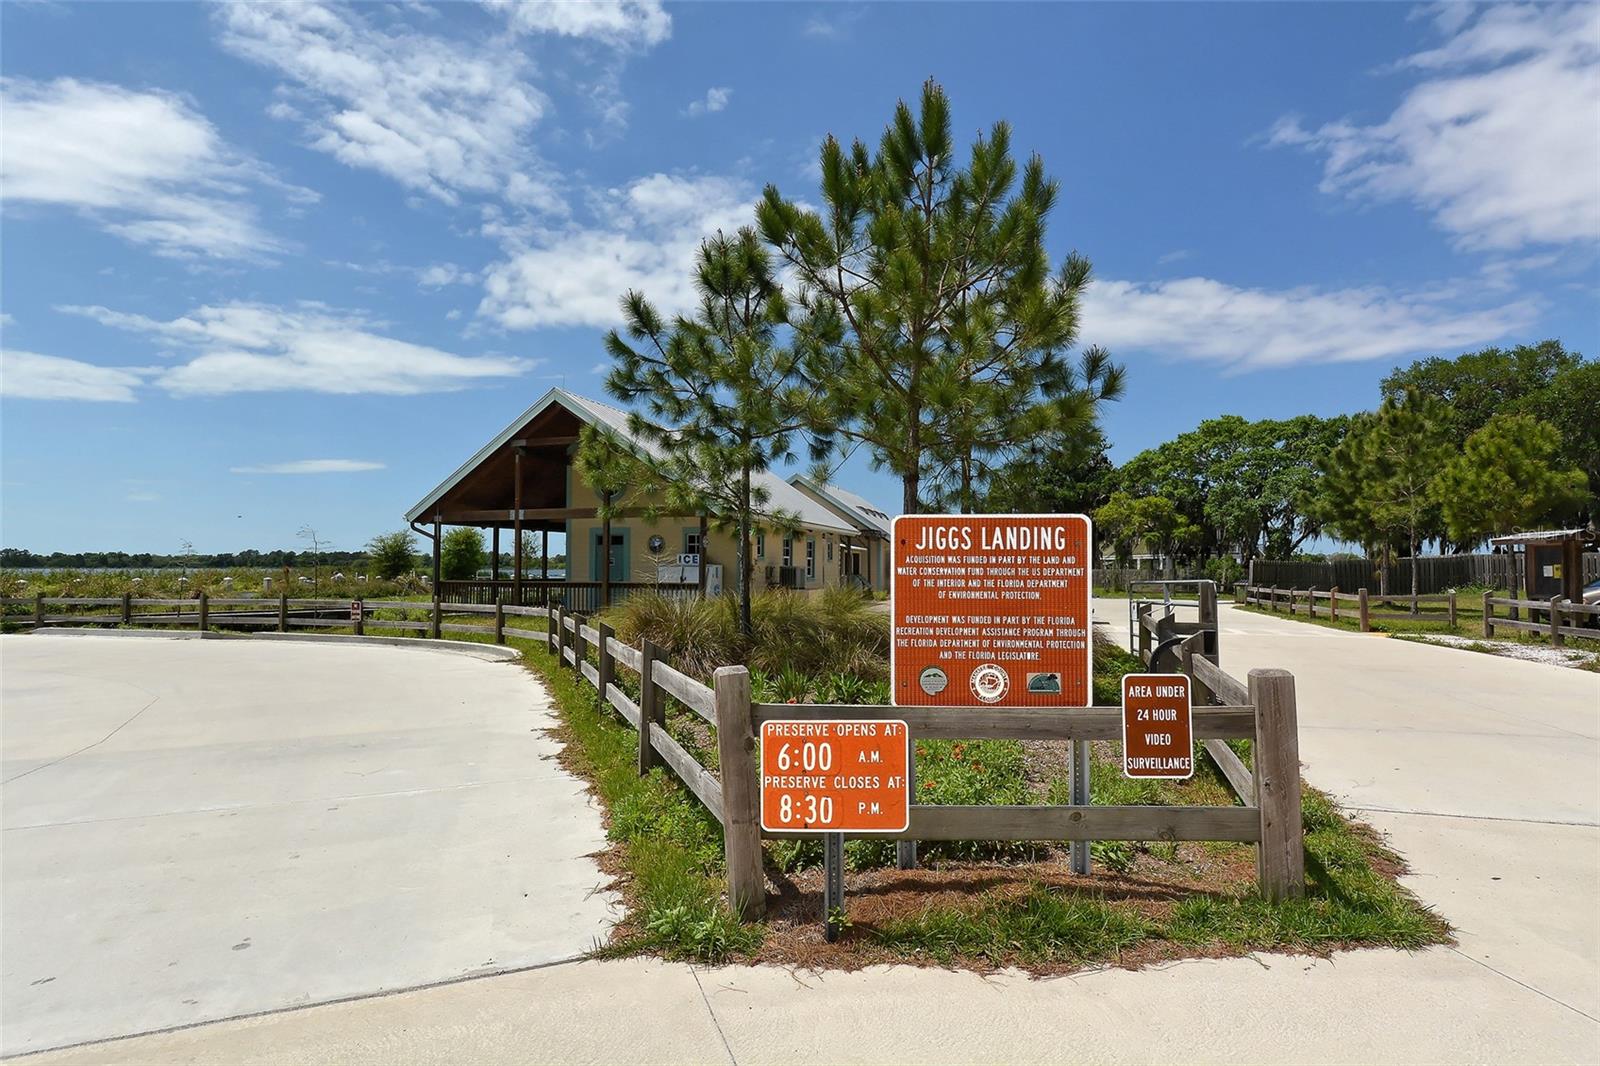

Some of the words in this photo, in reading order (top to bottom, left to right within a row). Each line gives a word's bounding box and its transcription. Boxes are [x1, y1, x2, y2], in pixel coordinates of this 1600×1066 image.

[916, 526, 972, 550] JIGGS
[982, 526, 1066, 550] LANDING
[679, 555, 698, 564] ICE
[906, 556, 945, 564] ACQUISITION
[948, 556, 961, 564] WAS
[963, 556, 987, 564] FUNDED
[990, 556, 996, 564] IN
[999, 556, 1014, 564] PART
[1018, 556, 1025, 564] BY
[1029, 556, 1040, 564] THE
[1043, 556, 1059, 564] LAND
[1063, 556, 1075, 564] AND
[898, 568, 917, 576] WATER
[920, 568, 965, 576] CONSERVATION
[968, 568, 983, 576] FUND
[987, 568, 1015, 576] THROUGH
[1019, 568, 1029, 576] THE
[1032, 568, 1040, 576] US
[1043, 568, 1084, 576] DEPARTMENT
[938, 591, 946, 600] OF
[949, 591, 999, 600] ENVIRONMENTAL
[1002, 591, 1041, 600] PROTECTION.
[906, 616, 949, 624] DEVELOPMENT
[952, 616, 965, 624] WAS
[968, 616, 992, 624] FUNDED
[994, 616, 1000, 624] IN
[1003, 616, 1019, 624] PART
[1022, 616, 1030, 624] BY
[1034, 616, 1045, 624] THE
[1048, 616, 1075, 624] FLORIDA
[896, 628, 933, 637] RECREATION
[936, 628, 979, 637] DEVELOPMENT
[982, 628, 1020, 637] ASSISTANCE
[1023, 628, 1053, 637] PROGRAM
[1056, 628, 1086, 637] THROUGH
[897, 640, 908, 648] THE
[911, 640, 937, 648] FLORIDA
[940, 640, 979, 648] DEPARTMENT
[983, 640, 990, 648] OF
[993, 640, 1043, 648] ENVIRONMENTAL
[1047, 640, 1085, 648] PROTECTION
[940, 652, 952, 660] AND
[955, 652, 966, 660] THE
[969, 652, 995, 660] FLORIDA
[998, 652, 1040, 660] LEGISLATURE.
[1129, 686, 1152, 697] AREA
[1156, 686, 1185, 697] UNDER
[1137, 709, 1149, 720] 24
[1153, 709, 1177, 720] HOUR
[768, 724, 829, 736] PRESERVE
[837, 724, 876, 736] OPENS
[885, 724, 902, 736] AT:
[1145, 734, 1171, 745] VIDEO
[778, 742, 832, 771] 6:00
[858, 751, 883, 763] A.M.
[1127, 758, 1190, 769] SURVEILLANCE
[765, 776, 826, 788] PRESERVE
[834, 776, 879, 788] CLOSES
[888, 776, 905, 788] AT:
[780, 795, 832, 824] 8:30
[858, 802, 883, 814] P.M.
